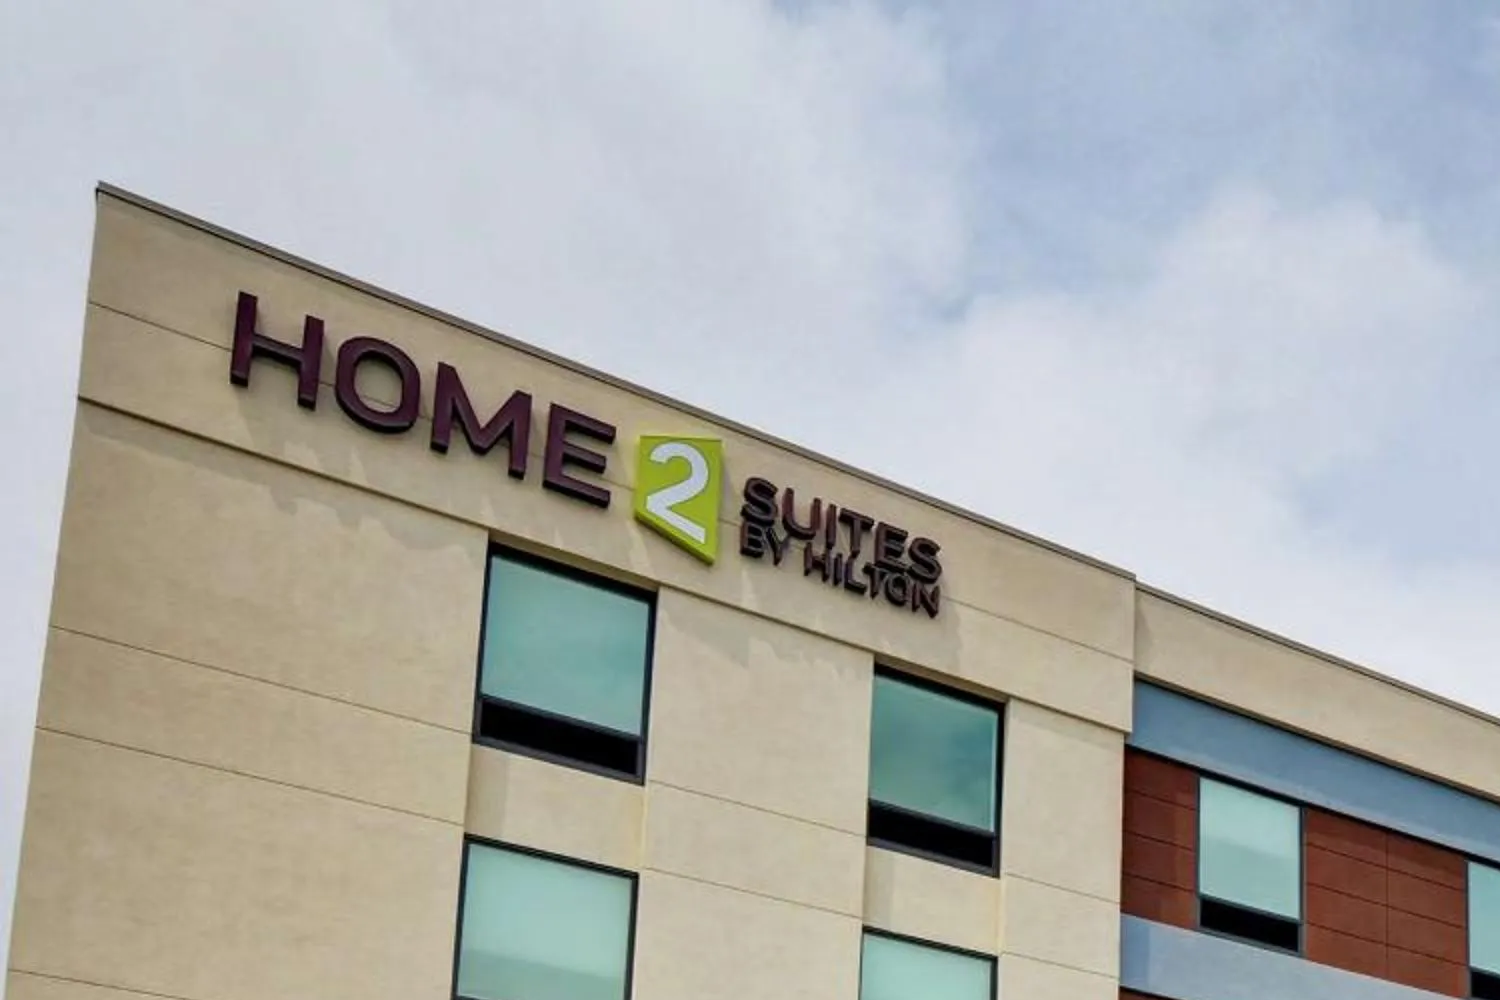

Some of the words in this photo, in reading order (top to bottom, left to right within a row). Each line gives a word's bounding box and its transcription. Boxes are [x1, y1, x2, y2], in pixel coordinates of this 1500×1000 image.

[230, 291, 617, 509] HOME
[644, 439, 710, 547] 2
[739, 521, 791, 567] BY
[803, 541, 941, 619] HILTON
[740, 477, 943, 585] SUITES
